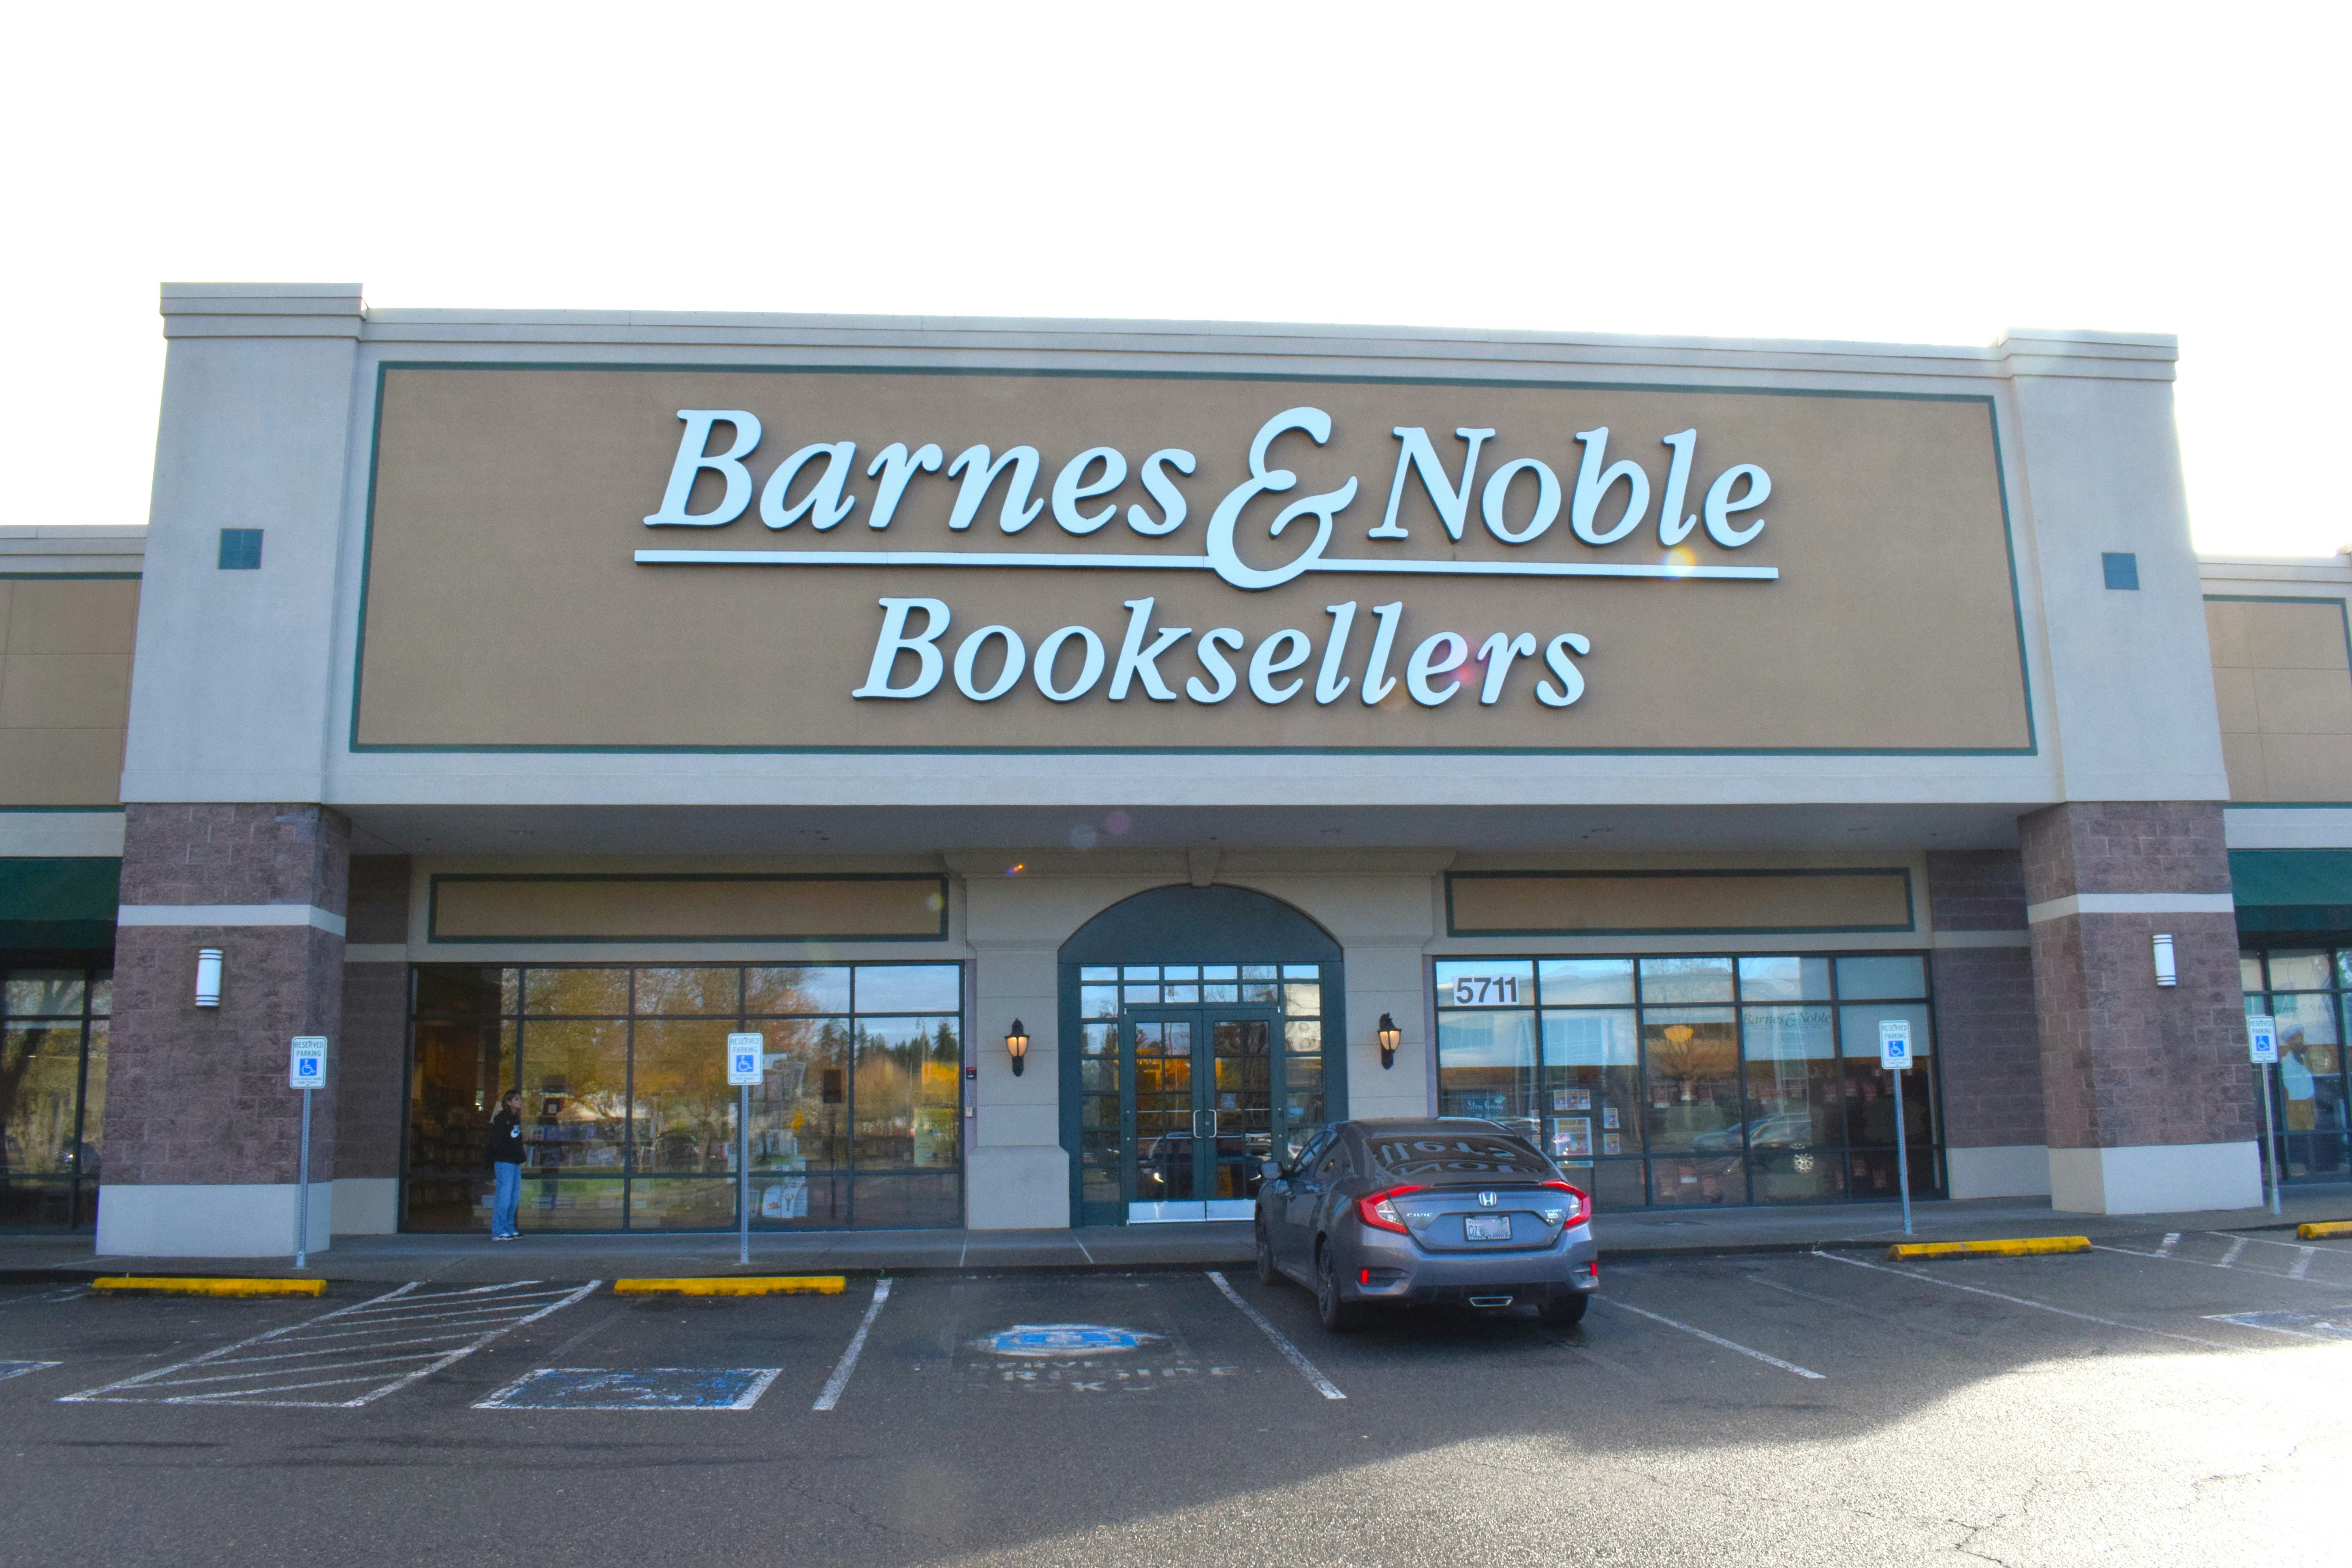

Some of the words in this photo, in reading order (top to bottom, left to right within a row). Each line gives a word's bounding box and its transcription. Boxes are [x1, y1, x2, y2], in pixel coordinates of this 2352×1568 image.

[643, 408, 1196, 536] Barnes
[1206, 406, 1358, 589] &
[1368, 426, 1772, 547] Noble
[852, 596, 1591, 707] Booksellers
[1456, 976, 1517, 1004] 5711
[1744, 1014, 1784, 1024] Barnes
[1798, 1012, 1831, 1023] Noble
